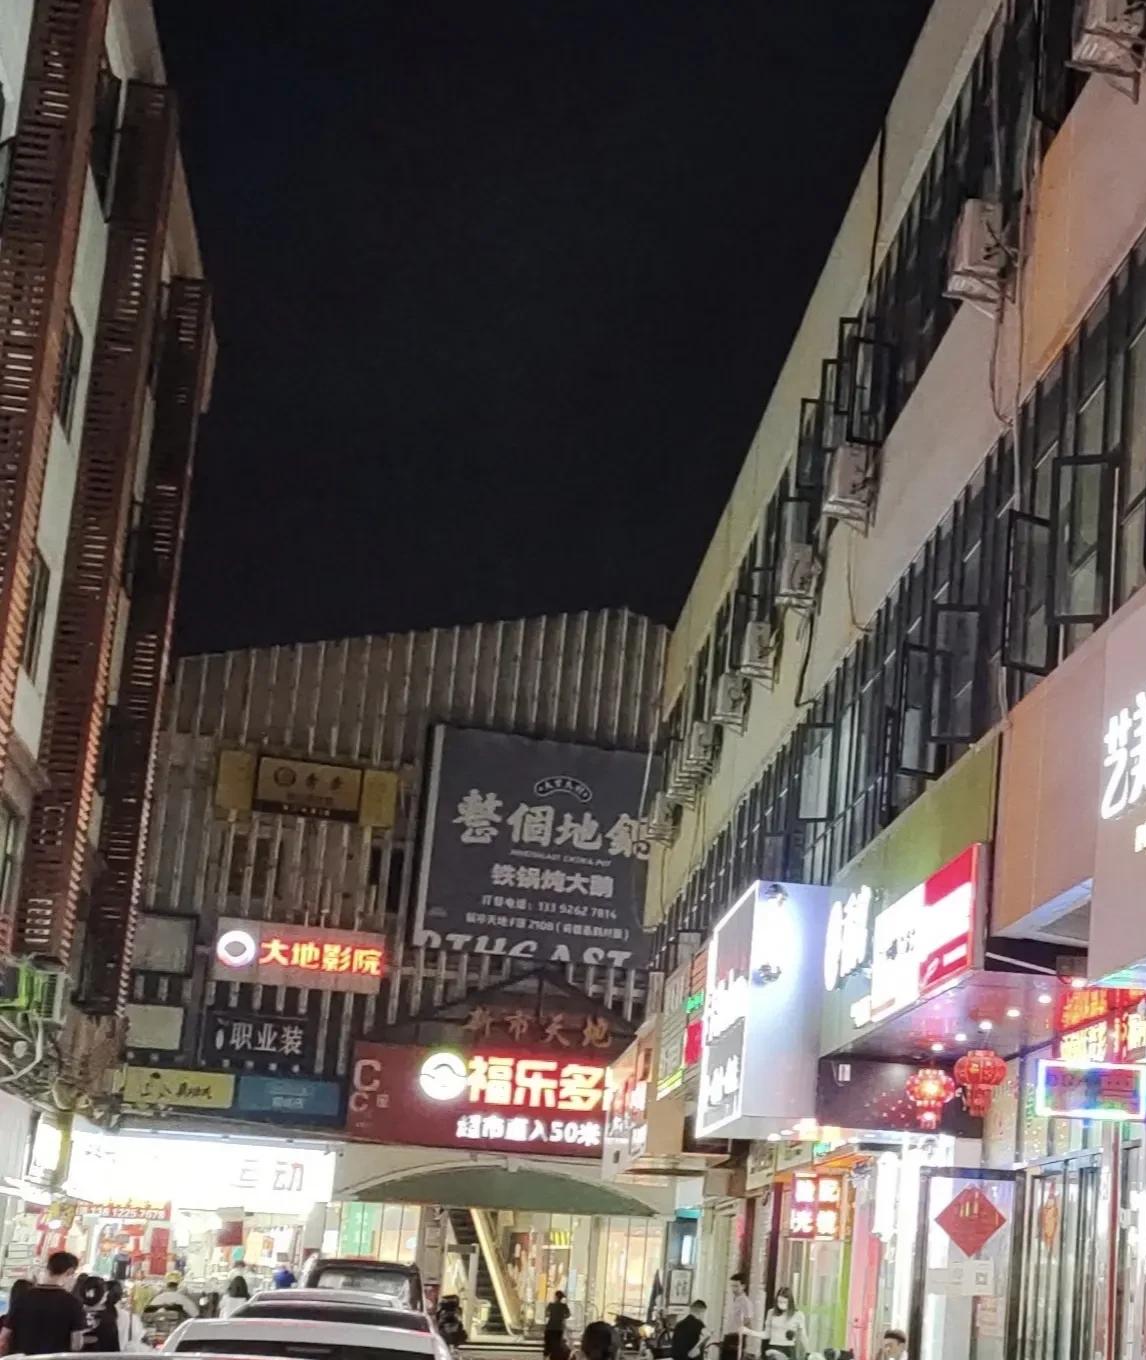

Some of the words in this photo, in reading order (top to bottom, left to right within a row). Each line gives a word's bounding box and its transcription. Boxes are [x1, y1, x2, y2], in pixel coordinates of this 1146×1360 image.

[259, 938, 384, 976] 大地影院
[353, 1059, 381, 1091] C
